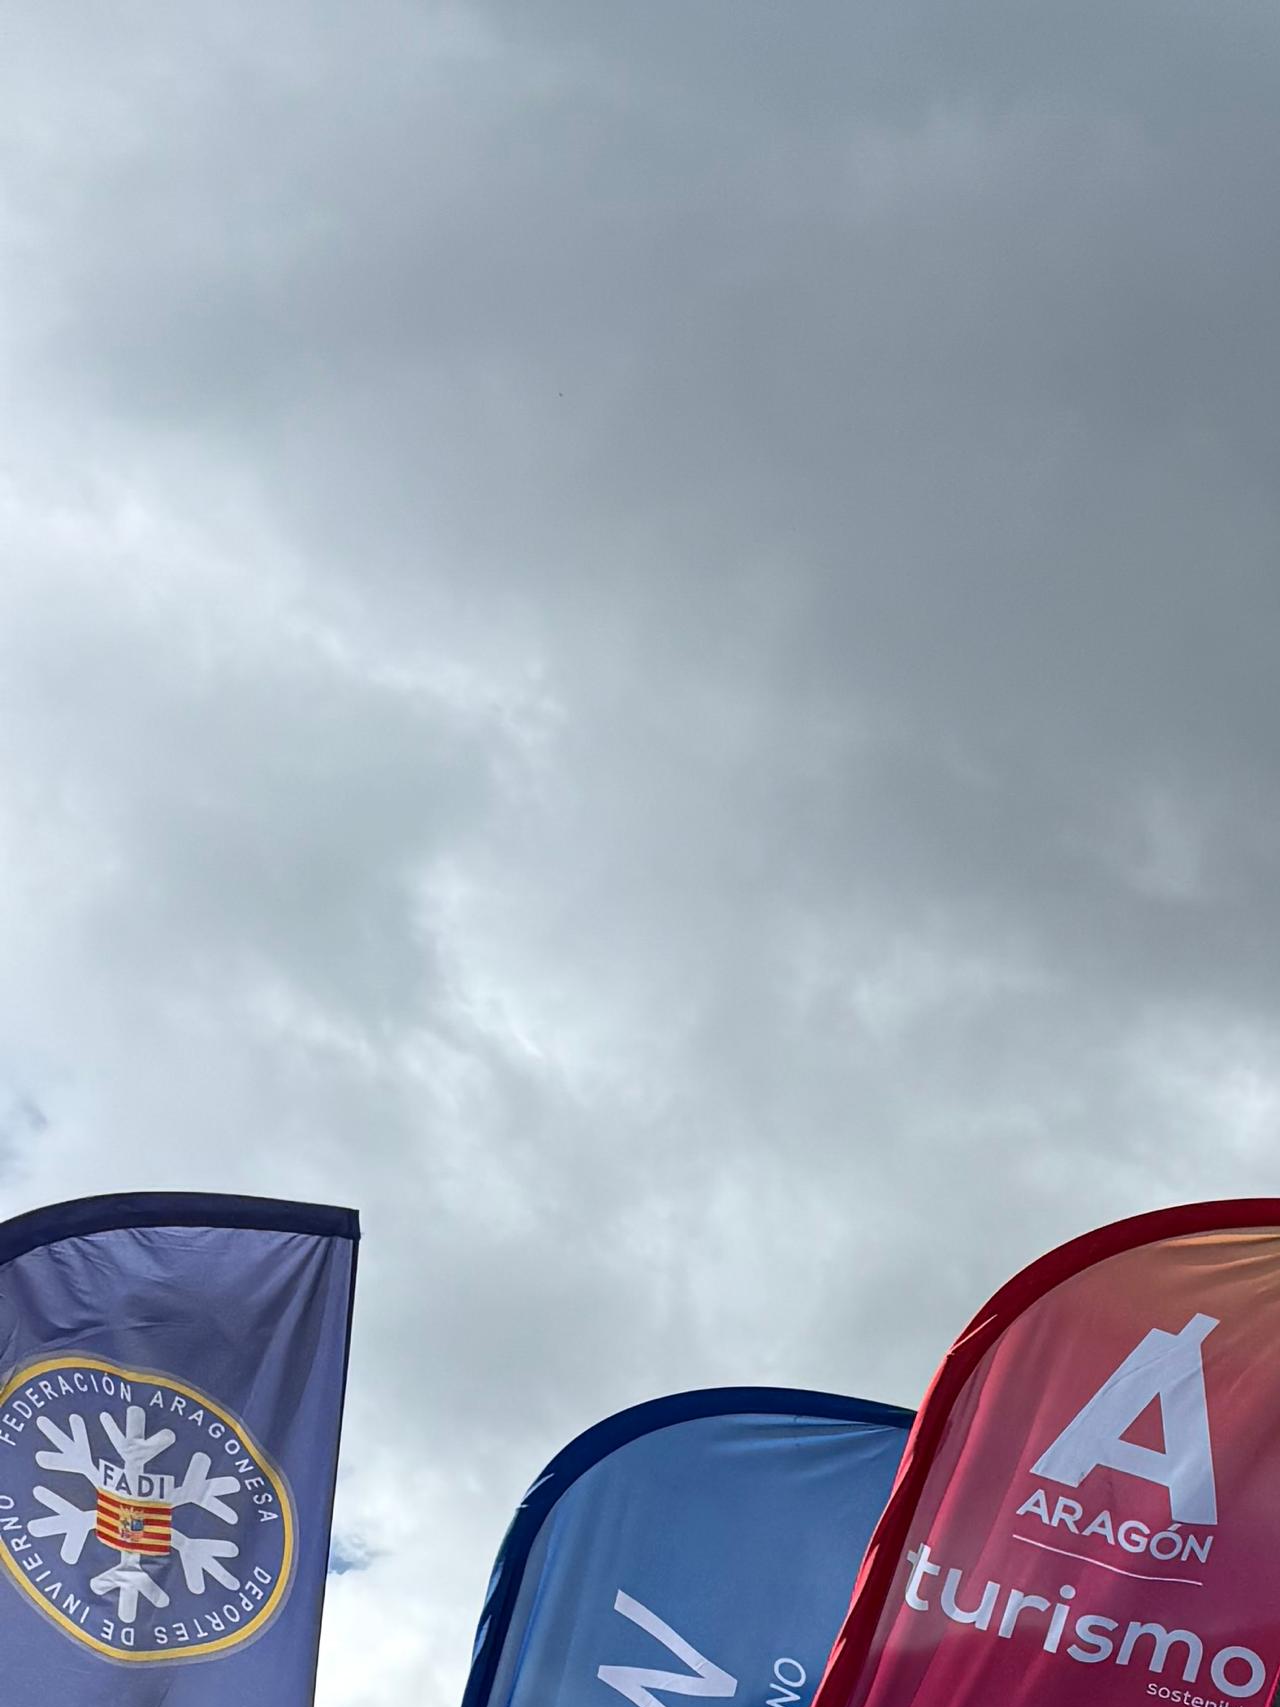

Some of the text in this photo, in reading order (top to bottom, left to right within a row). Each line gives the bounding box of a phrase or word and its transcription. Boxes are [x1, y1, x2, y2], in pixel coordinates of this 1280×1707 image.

[0, 1372, 279, 1523] FEDERACIÓN ARAGONESA
[103, 1464, 165, 1500] FADI
[1016, 1488, 1214, 1563] ARAGÓN
[100, 1619, 135, 1646] DE
[155, 1566, 272, 1645] DEPORTES
[905, 1542, 1267, 1698] turismo
